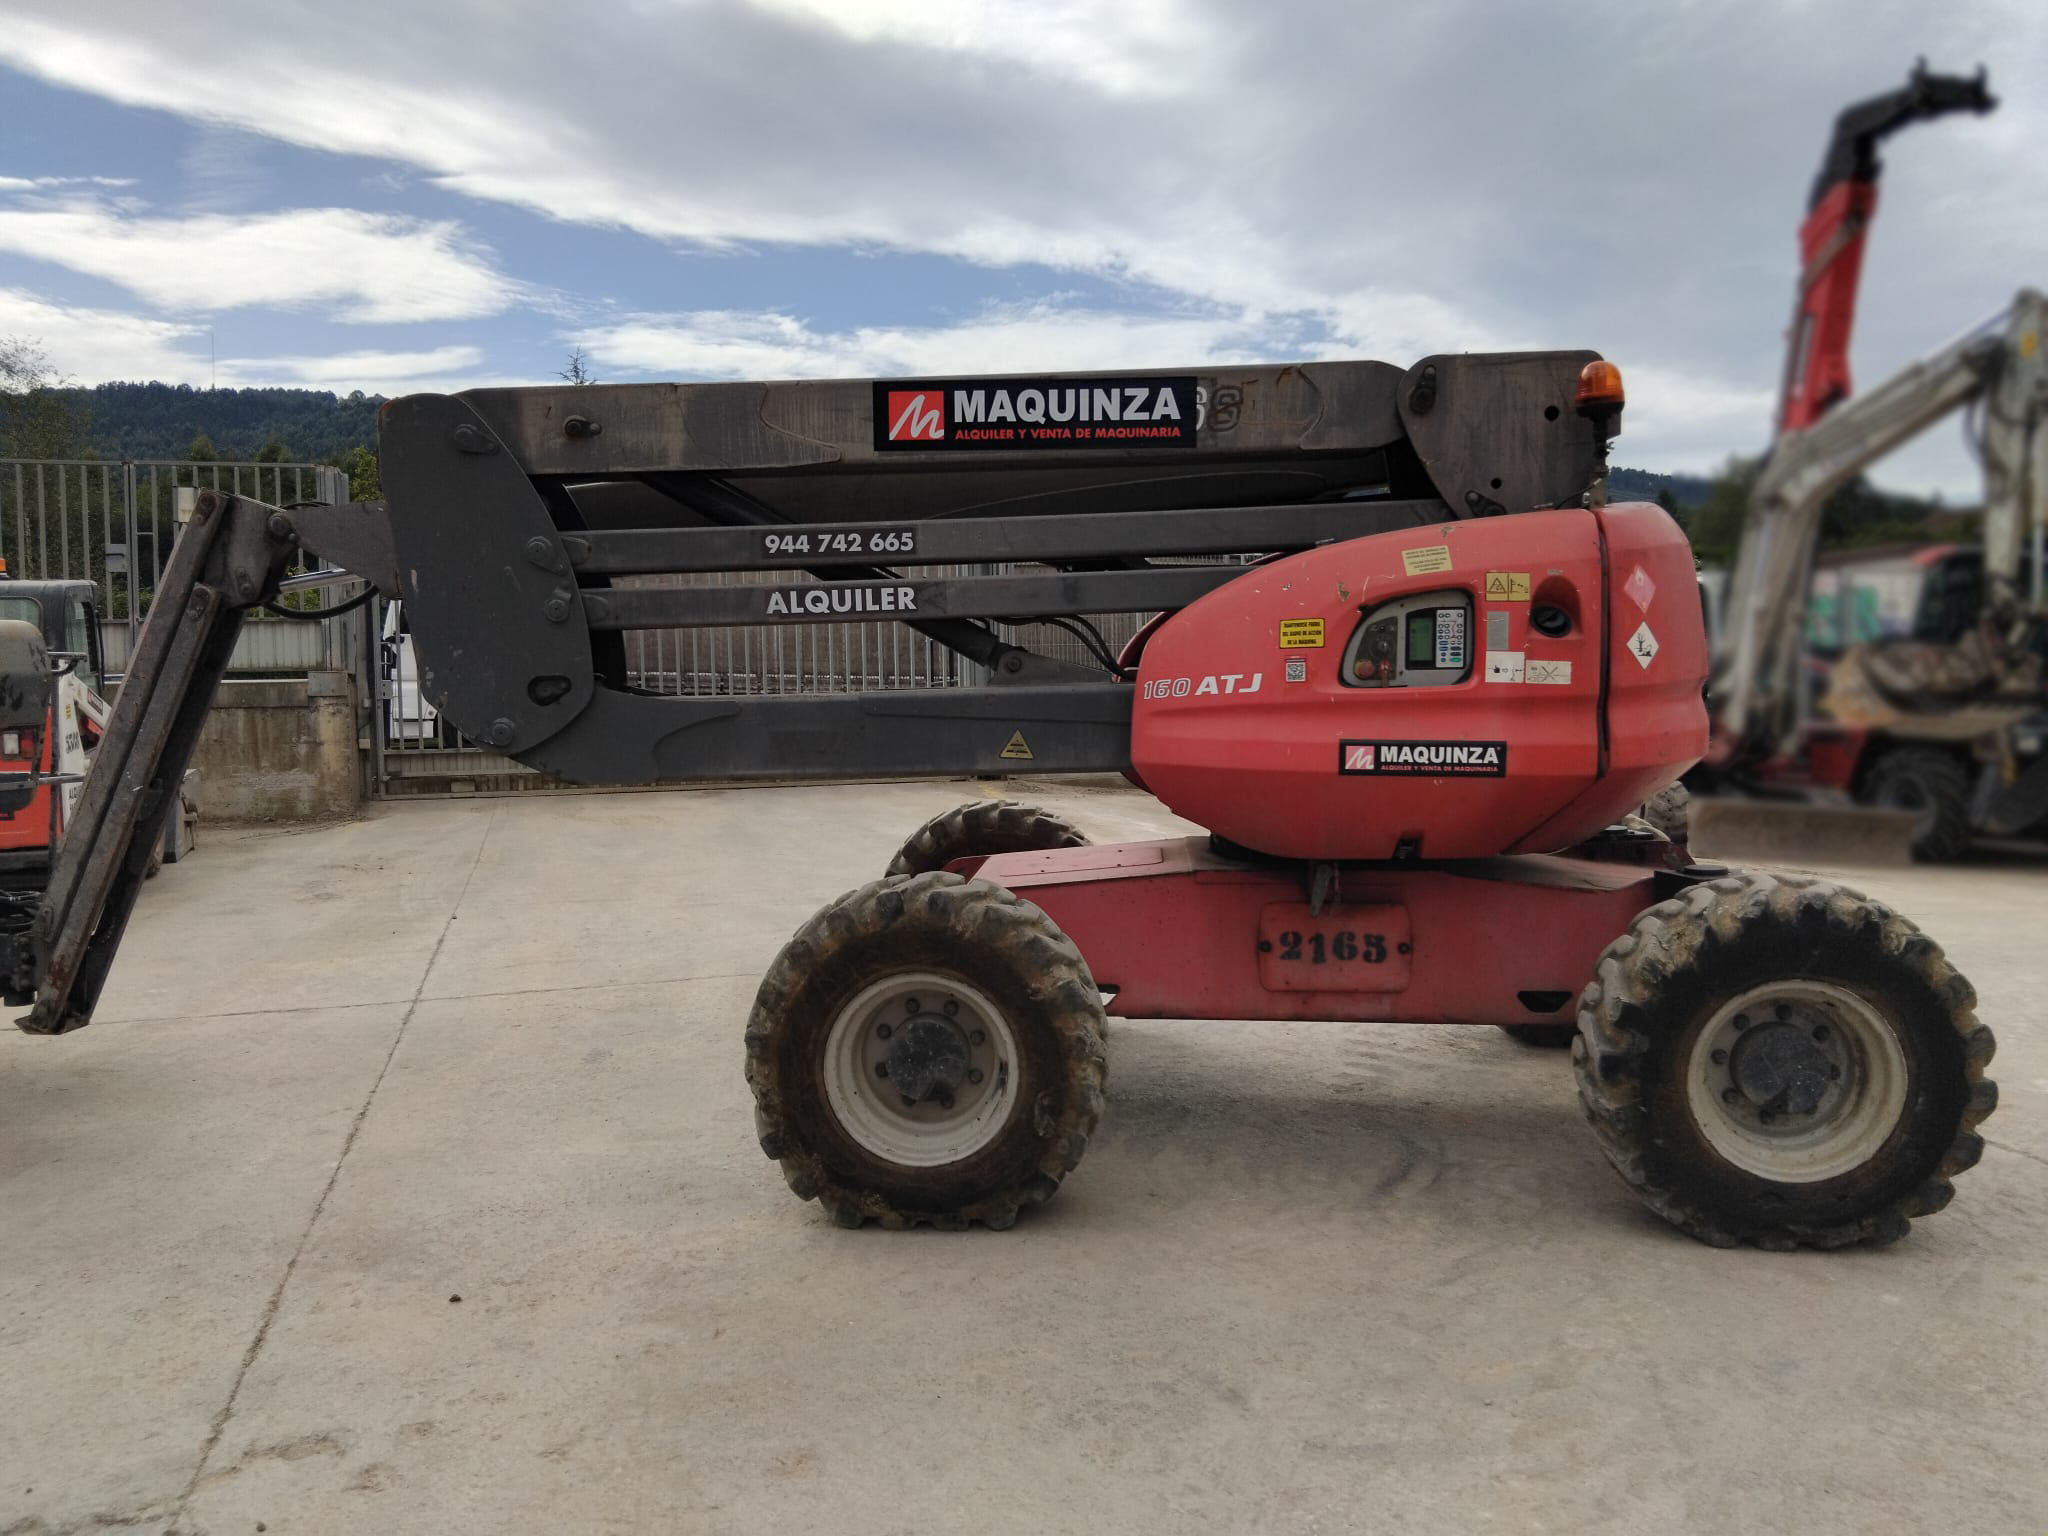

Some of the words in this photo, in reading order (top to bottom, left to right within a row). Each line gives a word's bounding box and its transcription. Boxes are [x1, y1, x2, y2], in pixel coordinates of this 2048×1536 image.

[953, 387, 1182, 424] MAQUINZA
[954, 429, 1014, 440] ALQUILER
[1018, 429, 1027, 439] Y
[1030, 428, 1071, 439] VENTA
[1075, 428, 1091, 438] DE
[1095, 426, 1181, 438] MAQUINARIA
[765, 534, 810, 554] 944
[817, 533, 862, 553] 742
[869, 532, 914, 552] 665
[766, 587, 917, 615] ALQUILER
[1143, 677, 1191, 700] 160
[1195, 673, 1263, 696] ATJ
[1380, 746, 1499, 764] MAQUINZA
[1279, 930, 1388, 965] 2165
